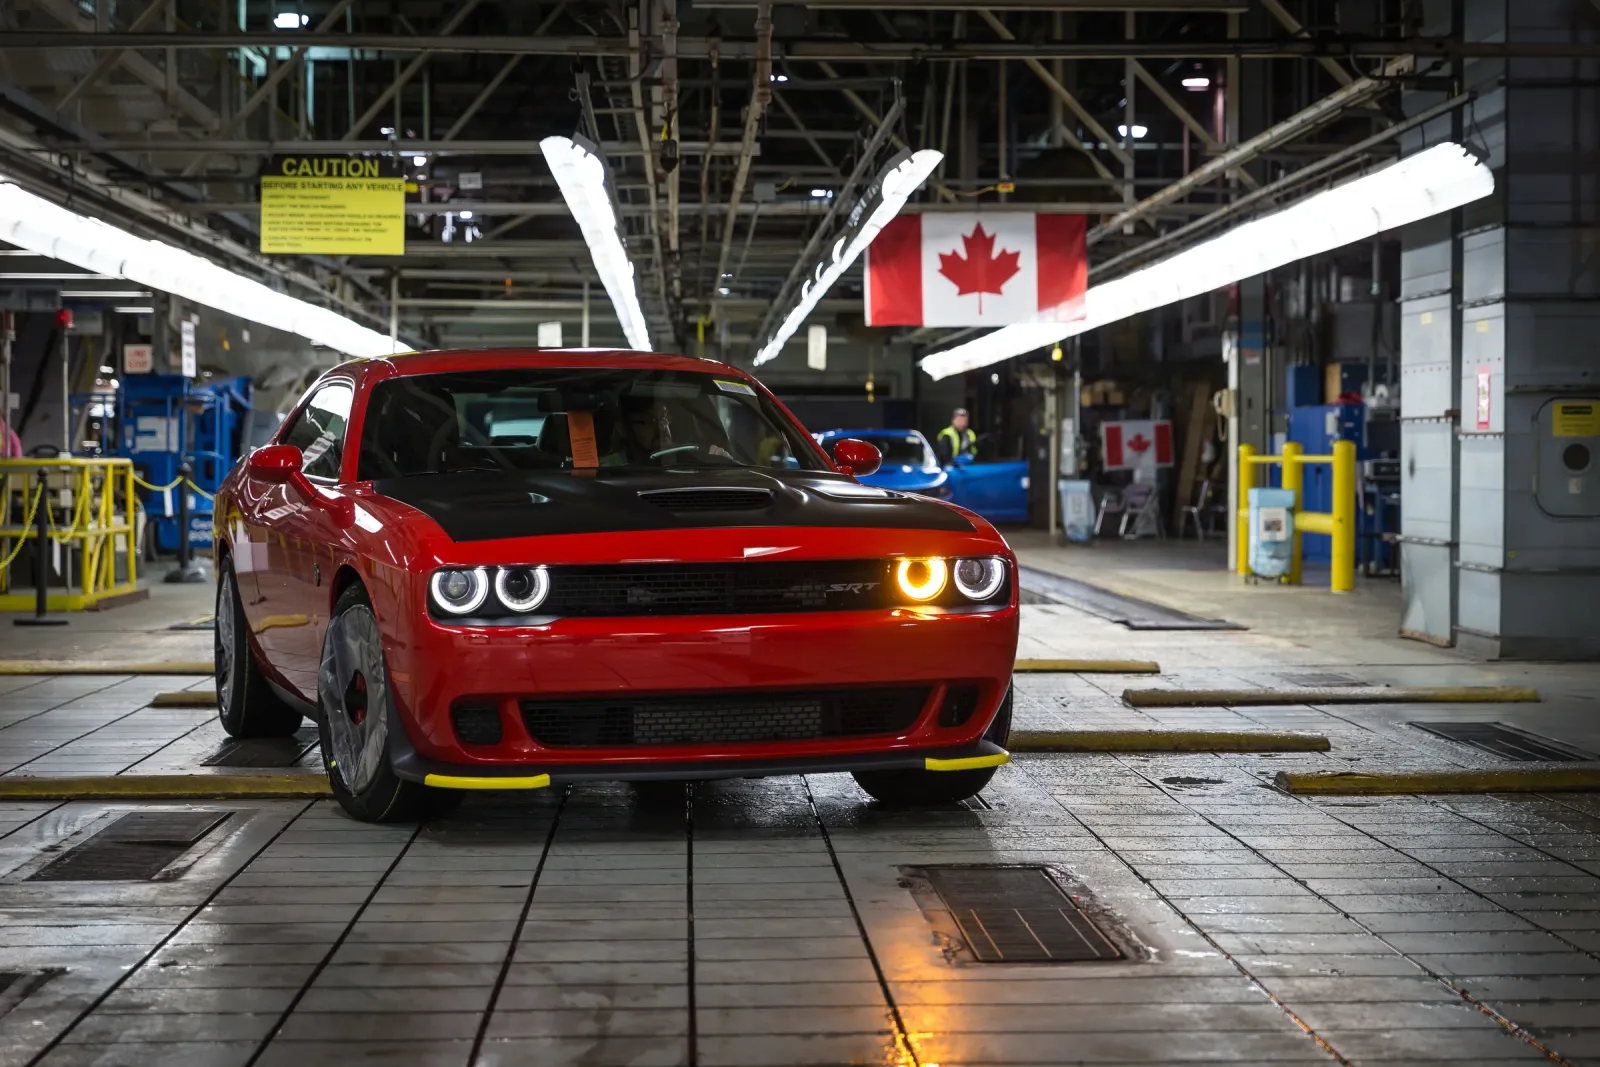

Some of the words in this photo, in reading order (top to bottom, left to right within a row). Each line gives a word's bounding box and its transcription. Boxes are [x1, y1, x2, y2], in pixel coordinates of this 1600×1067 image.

[281, 157, 379, 177] CAUTION
[263, 181, 297, 189] BEFORE
[301, 181, 342, 189] STARTING
[345, 182, 363, 190] ANY
[366, 183, 402, 192] VEHICLE
[826, 583, 880, 594] SRT
